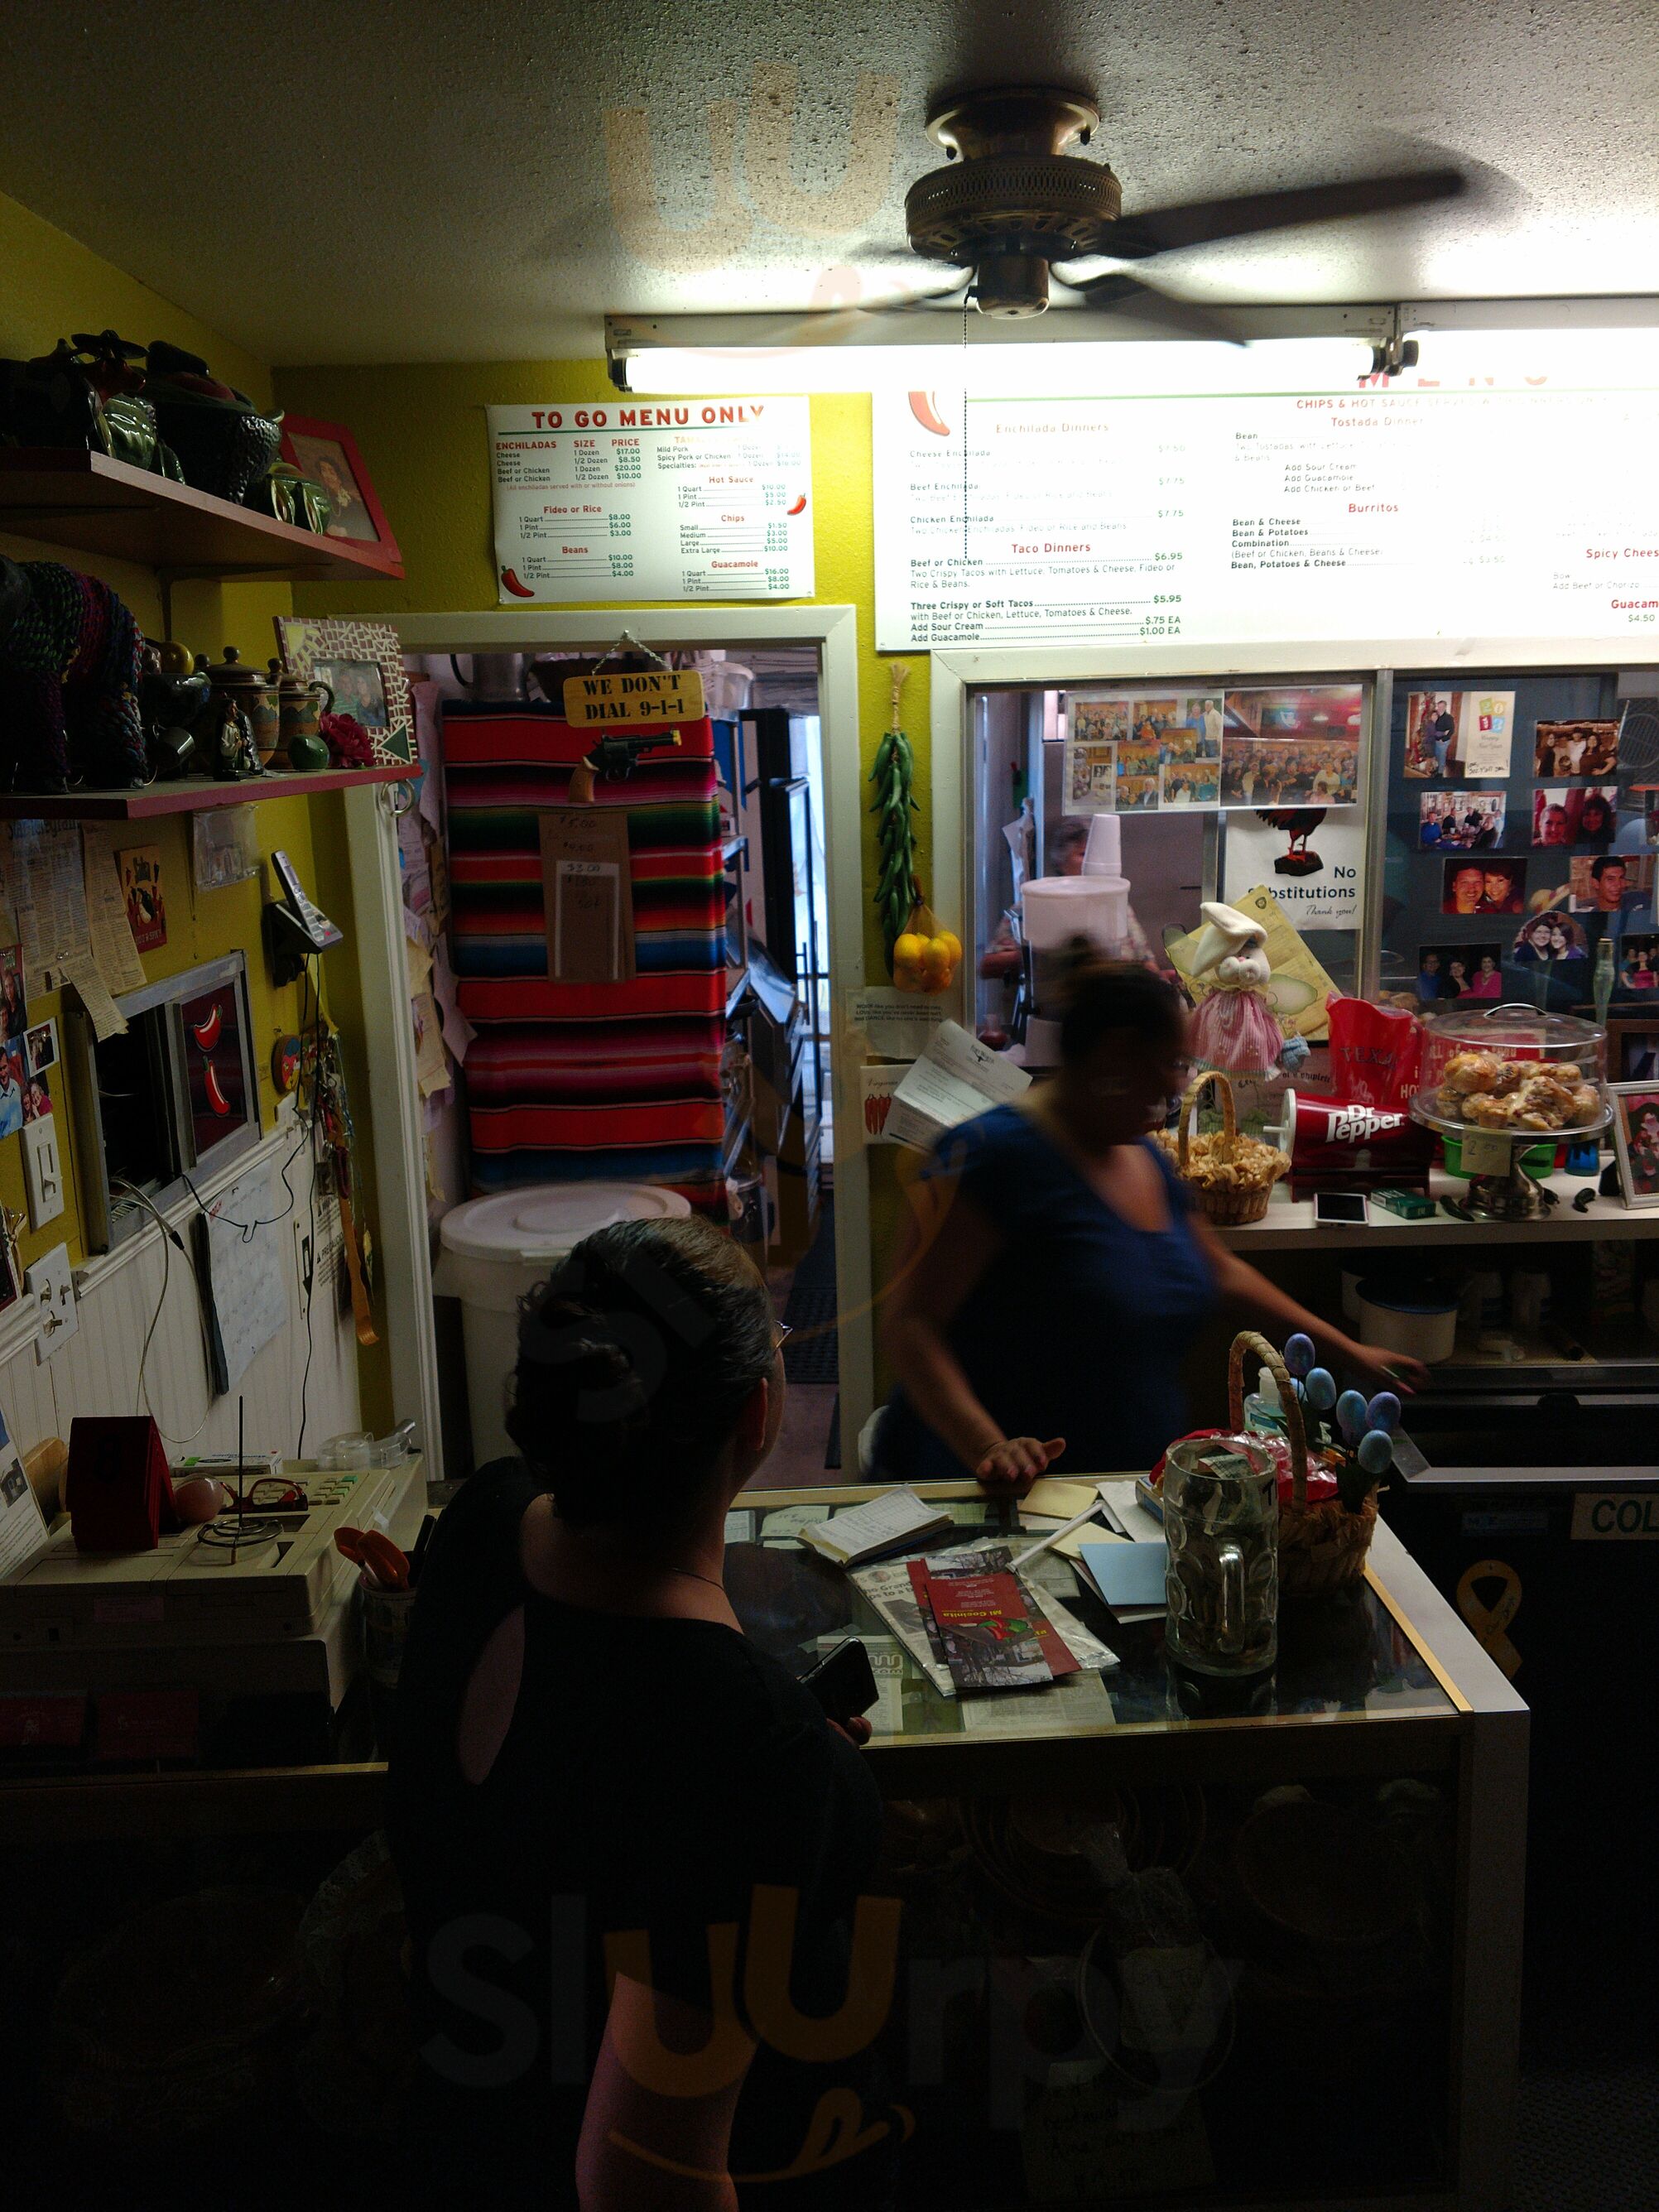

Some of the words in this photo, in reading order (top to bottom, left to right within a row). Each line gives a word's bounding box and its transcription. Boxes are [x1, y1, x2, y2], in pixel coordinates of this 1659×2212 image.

[1296, 399, 1334, 409] CHIPS
[1339, 399, 1345, 408] &
[1352, 399, 1375, 408] HOT
[531, 411, 562, 428] TO
[575, 410, 607, 427] GO
[619, 407, 689, 426] MENU
[702, 406, 763, 423] ONLY
[1331, 417, 1378, 426] Tostada
[996, 424, 1056, 433] Enchilada
[1062, 423, 1108, 431] Dinners
[496, 441, 556, 450] ENCHILADAS
[1348, 503, 1399, 513] Burritos
[1233, 518, 1254, 527] Bean
[1268, 517, 1301, 526] Cheese
[1268, 528, 1308, 536] Potatoes
[1012, 544, 1038, 554] Taco
[1045, 543, 1090, 553] Dinners
[1586, 548, 1618, 560] Spicy
[1155, 552, 1183, 561] $6.95
[1231, 561, 1257, 570] Bean,
[930, 570, 957, 578] Crispy
[961, 569, 984, 577] Tacos
[1049, 566, 1090, 575] Tomatoes
[932, 580, 939, 589] &
[911, 602, 936, 610] Three
[940, 601, 969, 610] Crispy
[1008, 599, 1033, 608] Tacos
[1153, 595, 1181, 603] $5.95
[1611, 599, 1659, 608] Guacam
[932, 612, 951, 620] Beef
[966, 611, 1003, 619] Chicken,
[1007, 610, 1041, 618] Lettuce,
[1045, 608, 1086, 617] Tomatoes
[1099, 607, 1132, 616] Cheese.
[1628, 614, 1655, 623] $4.50
[911, 623, 928, 632] Add
[931, 623, 951, 631] Sour
[1146, 616, 1165, 625] $.75
[931, 633, 980, 642] Guacamole
[1140, 627, 1165, 636] $1.00
[583, 679, 612, 695] WE
[621, 674, 680, 694] DON'T
[585, 702, 630, 719] DIAL
[640, 699, 684, 716] 9-1-1
[1334, 866, 1356, 878] No
[1248, 886, 1355, 899] bstitutions
[1306, 905, 1332, 916] Thank
[1400, 1084, 1419, 1099] HO
[1347, 1104, 1375, 1119] Dr
[1325, 1113, 1403, 1143] Pepper
